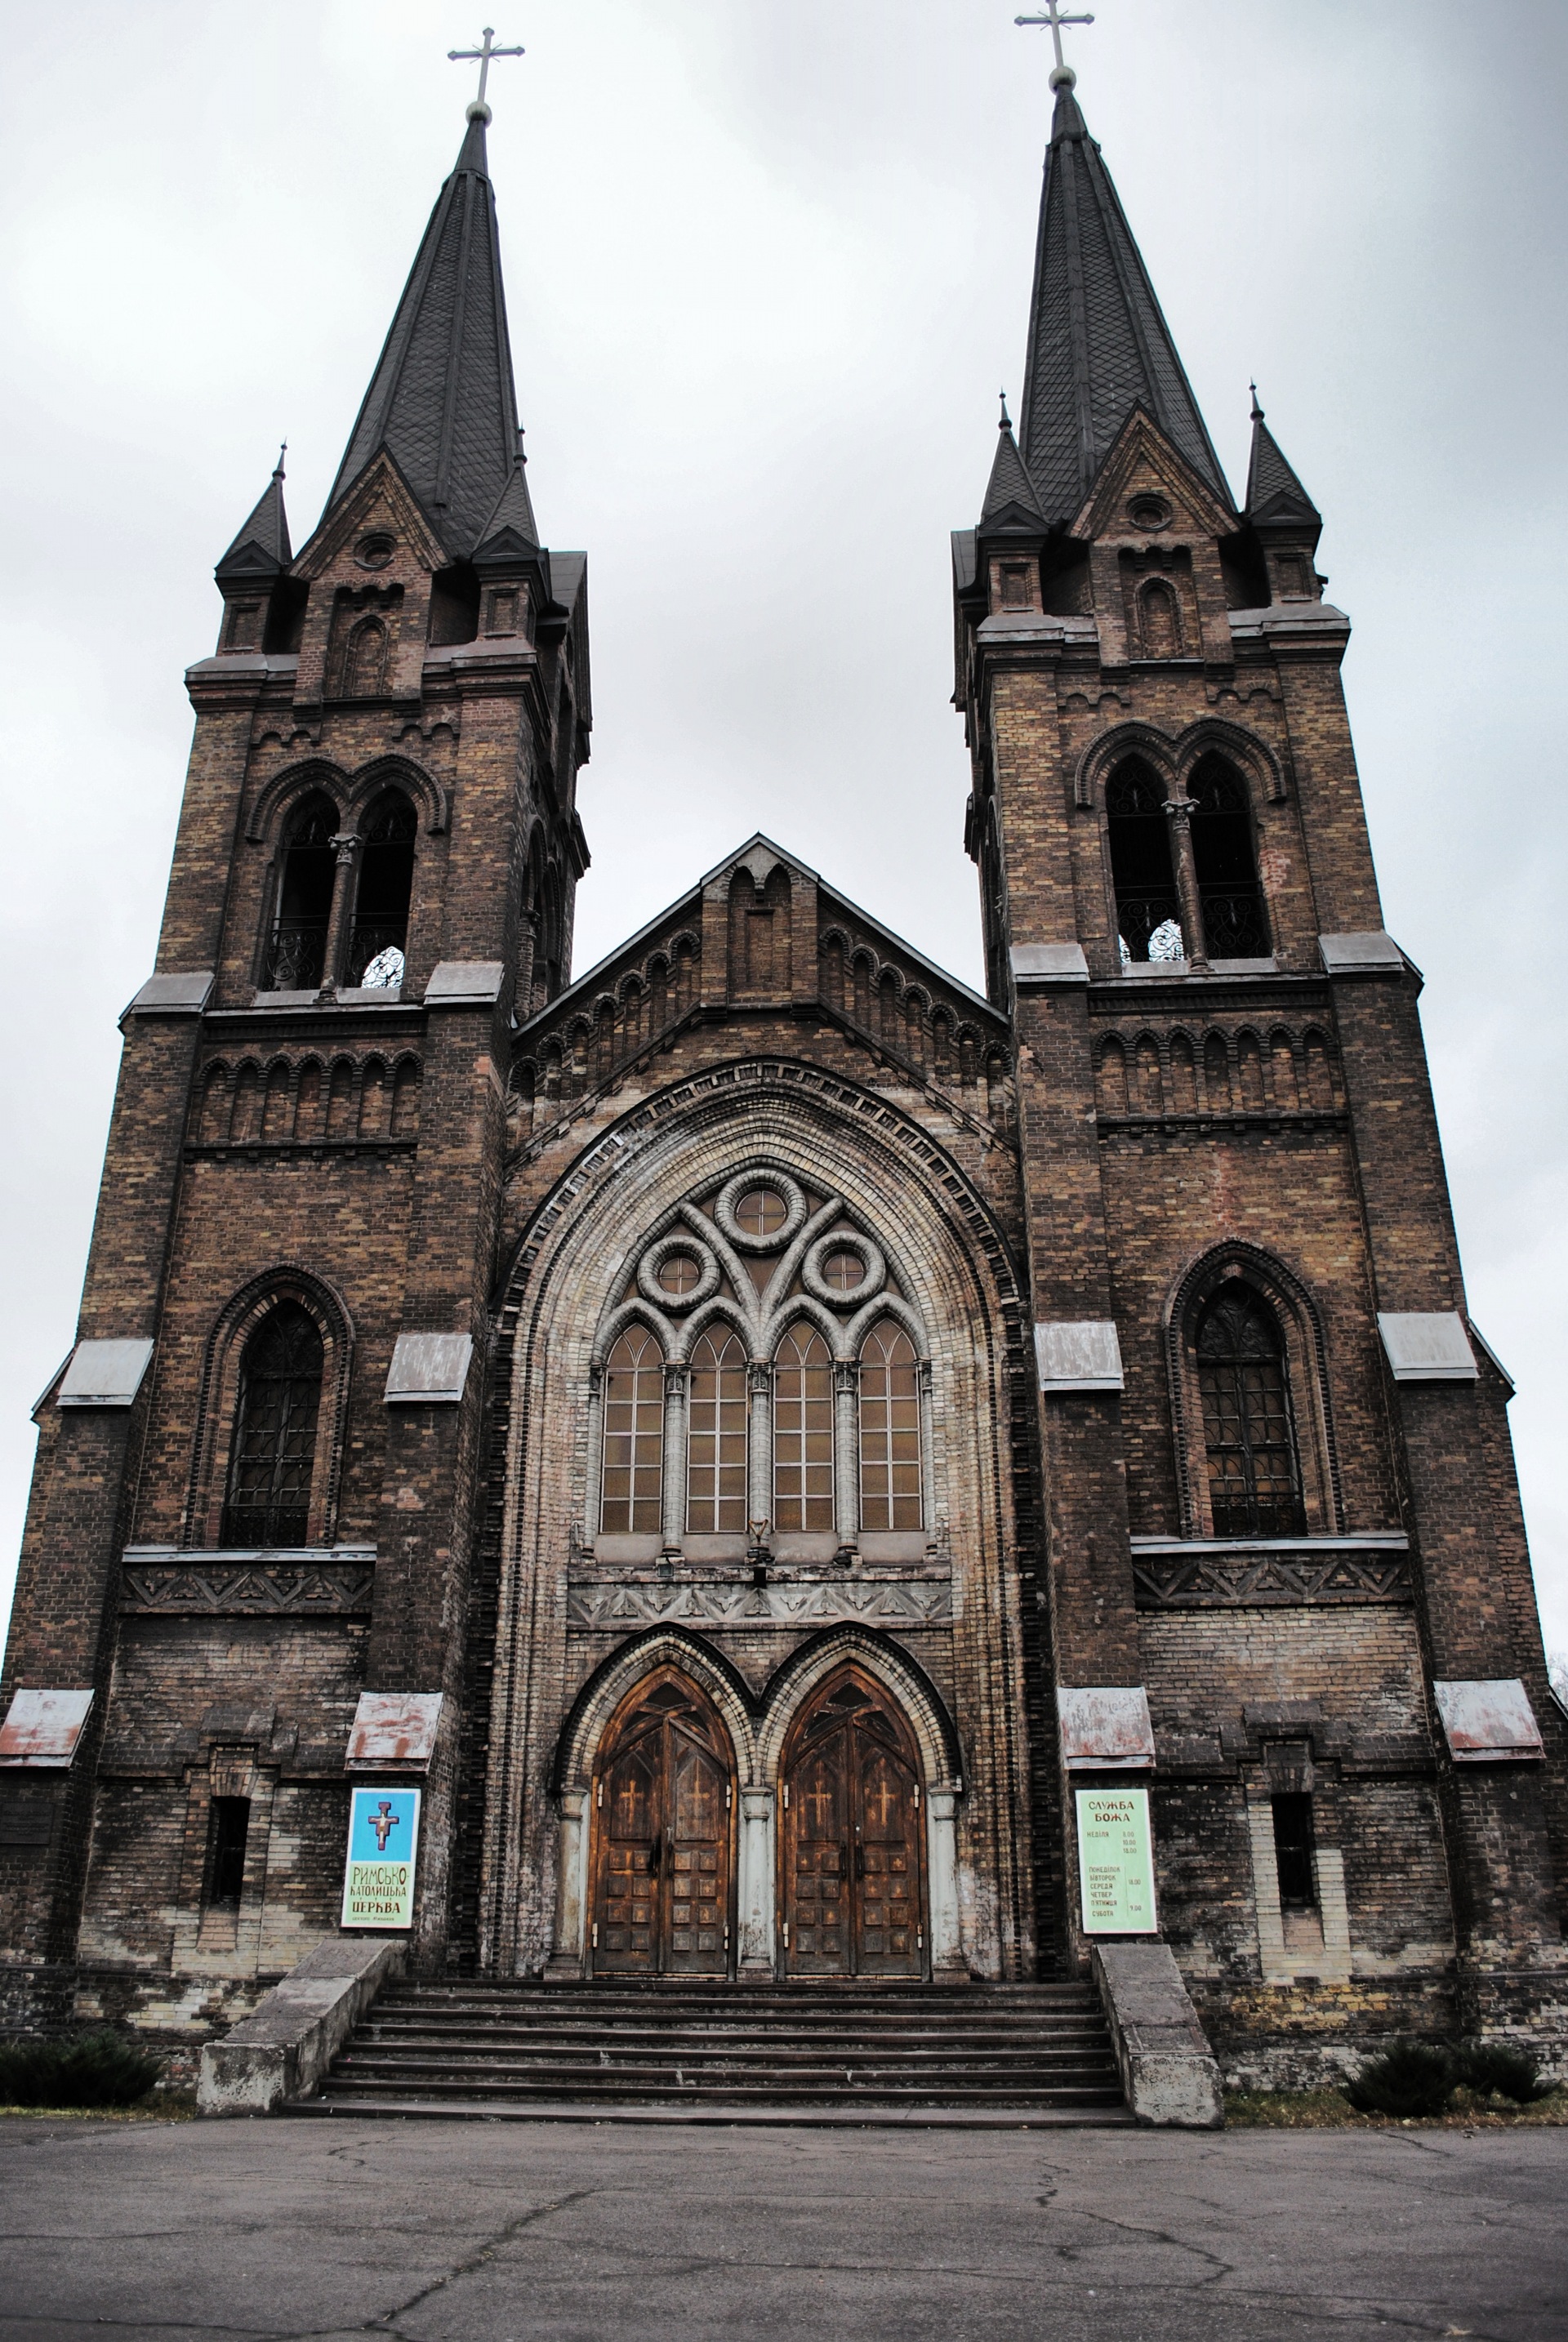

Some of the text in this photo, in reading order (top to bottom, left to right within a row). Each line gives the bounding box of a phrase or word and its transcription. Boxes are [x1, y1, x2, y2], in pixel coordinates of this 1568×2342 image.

[1089, 1801, 1134, 1810] СЛУЖБА
[1095, 1813, 1130, 1822] БОЖА
[353, 1867, 410, 1885] РИМСЬКО-
[350, 1886, 407, 1897] КАТОЛИЦЬКА
[352, 1901, 400, 1913] ЦЕРКВА
